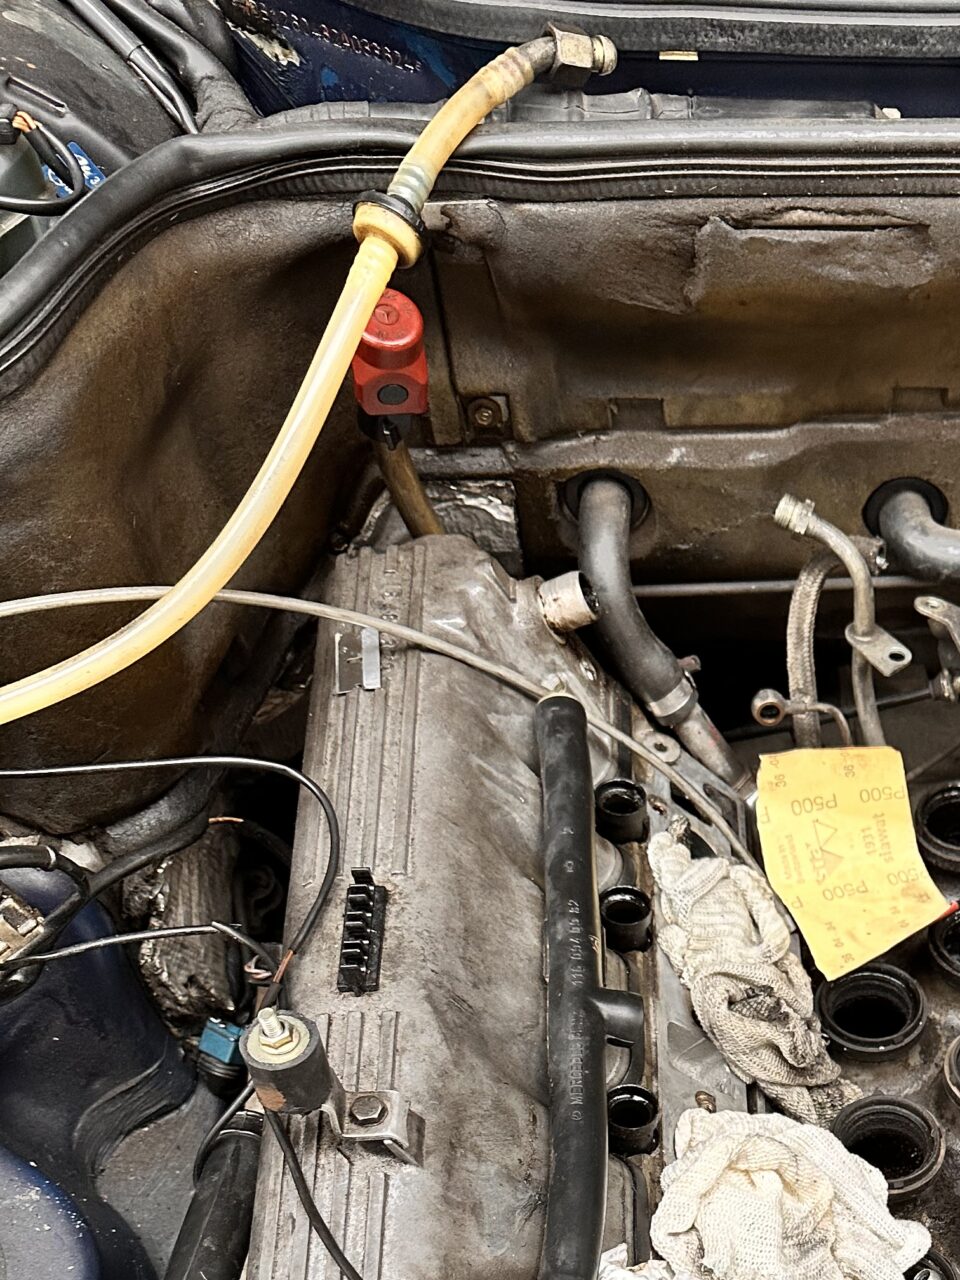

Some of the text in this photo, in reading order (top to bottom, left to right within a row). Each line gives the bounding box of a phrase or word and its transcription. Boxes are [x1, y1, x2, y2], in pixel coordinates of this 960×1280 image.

[791, 792, 838, 817] P500
[859, 785, 906, 804] P500
[860, 826, 876, 856] 1931
[872, 811, 895, 864] siawat
[822, 880, 869, 902] P500
